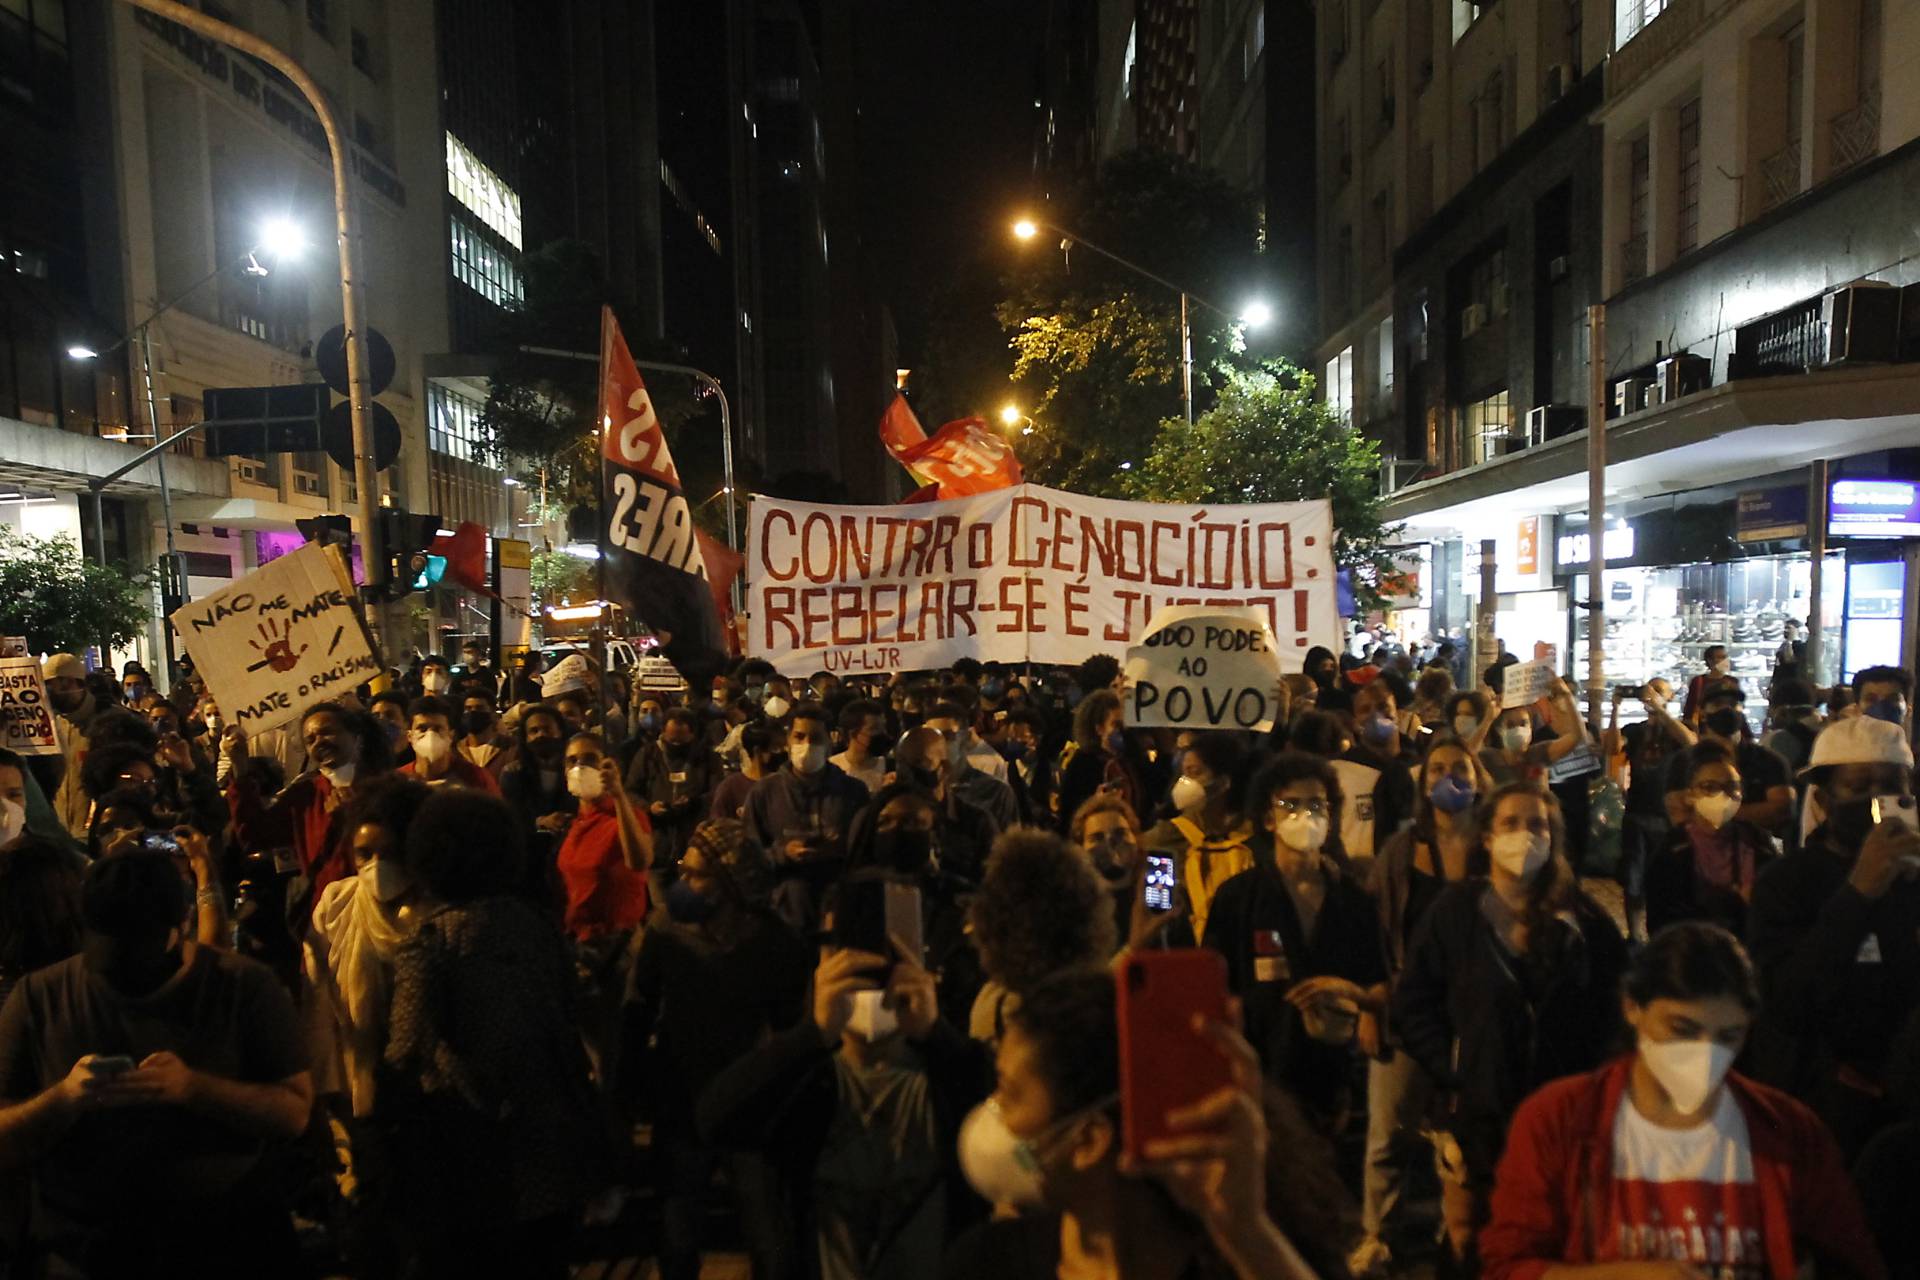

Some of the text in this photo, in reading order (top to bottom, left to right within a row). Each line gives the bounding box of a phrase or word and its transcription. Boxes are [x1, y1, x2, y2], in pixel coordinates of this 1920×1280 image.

[761, 508, 960, 584] CONTRA
[191, 590, 347, 633] NÃO ME MATE
[763, 577, 1047, 649] REBELAR-SE
[1064, 573, 1091, 636] É
[823, 647, 900, 671] UV-LJR
[1145, 625, 1269, 653] UDO PODE
[1177, 656, 1208, 677] AO
[1, 689, 40, 708] AO
[236, 691, 292, 725] MATE
[297, 684, 309, 697] O
[1134, 680, 1267, 728] POVO
